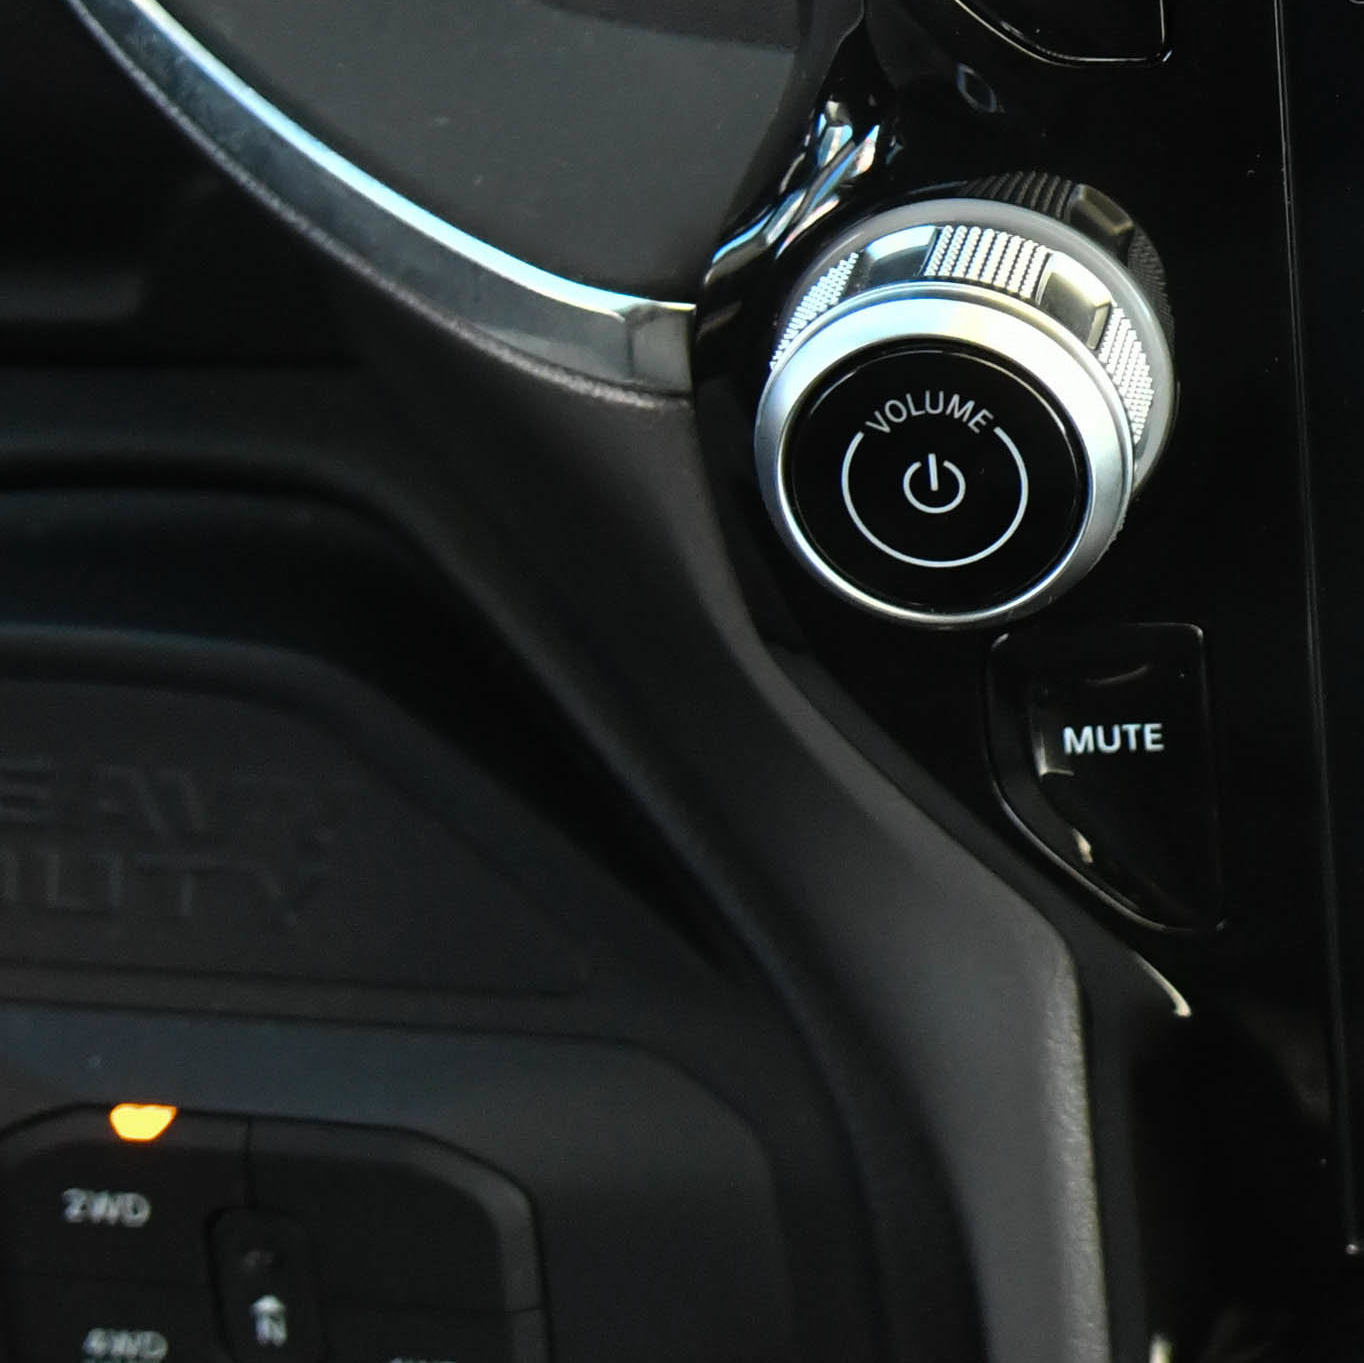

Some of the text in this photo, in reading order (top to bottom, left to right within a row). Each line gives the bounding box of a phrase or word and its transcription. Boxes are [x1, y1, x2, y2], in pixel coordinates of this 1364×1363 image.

[865, 390, 995, 435] VOLUME
[1063, 723, 1164, 754] MUTE
[62, 1187, 151, 1226] 2WD
